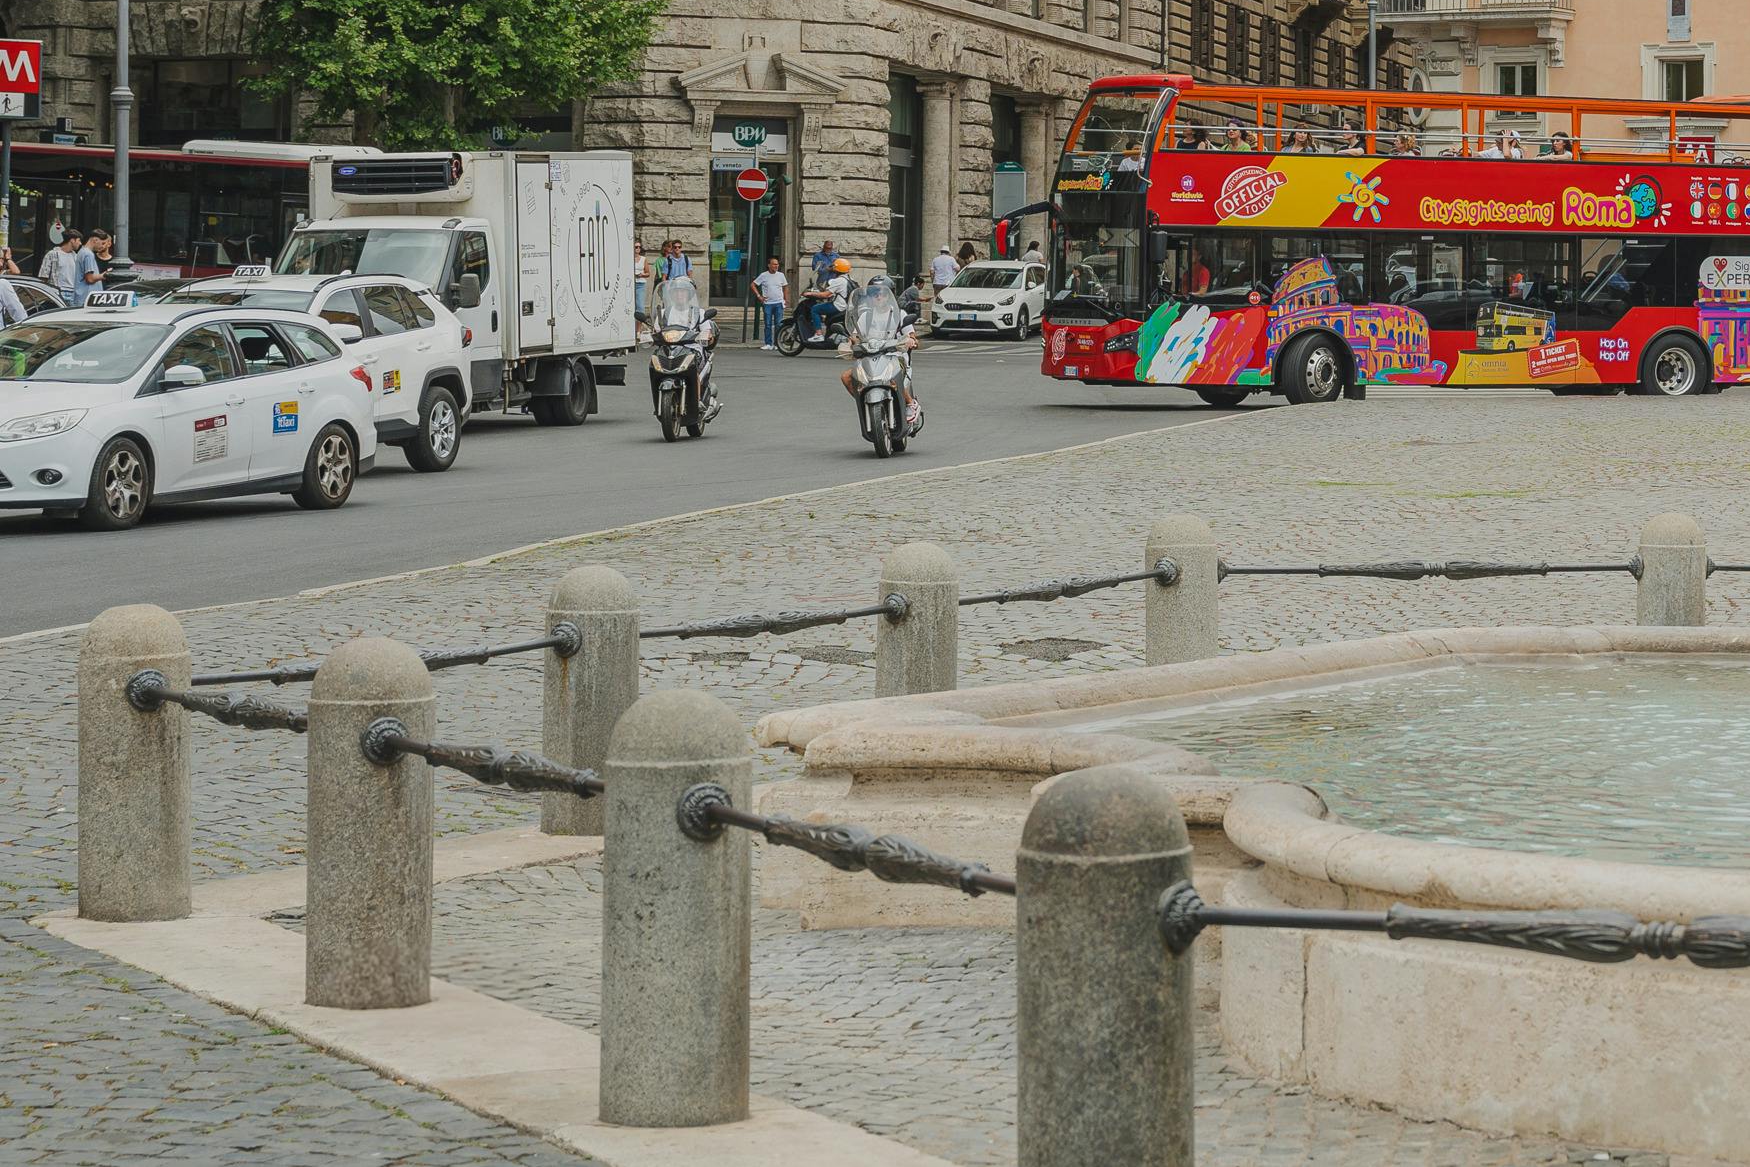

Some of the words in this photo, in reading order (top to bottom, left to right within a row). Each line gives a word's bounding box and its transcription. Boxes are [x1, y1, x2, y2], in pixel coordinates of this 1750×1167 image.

[0, 49, 37, 83] M
[734, 126, 766, 141] BPM
[1222, 173, 1284, 213] OFFICIAL
[1245, 194, 1273, 214] TOUR
[237, 267, 265, 276] TAXI
[92, 293, 123, 305] TAXI
[1600, 338, 1615, 349] Hop
[1617, 338, 1628, 348] On
[1545, 345, 1566, 356] TICKET
[1600, 351, 1615, 361] Hop
[1617, 351, 1630, 361] Off
